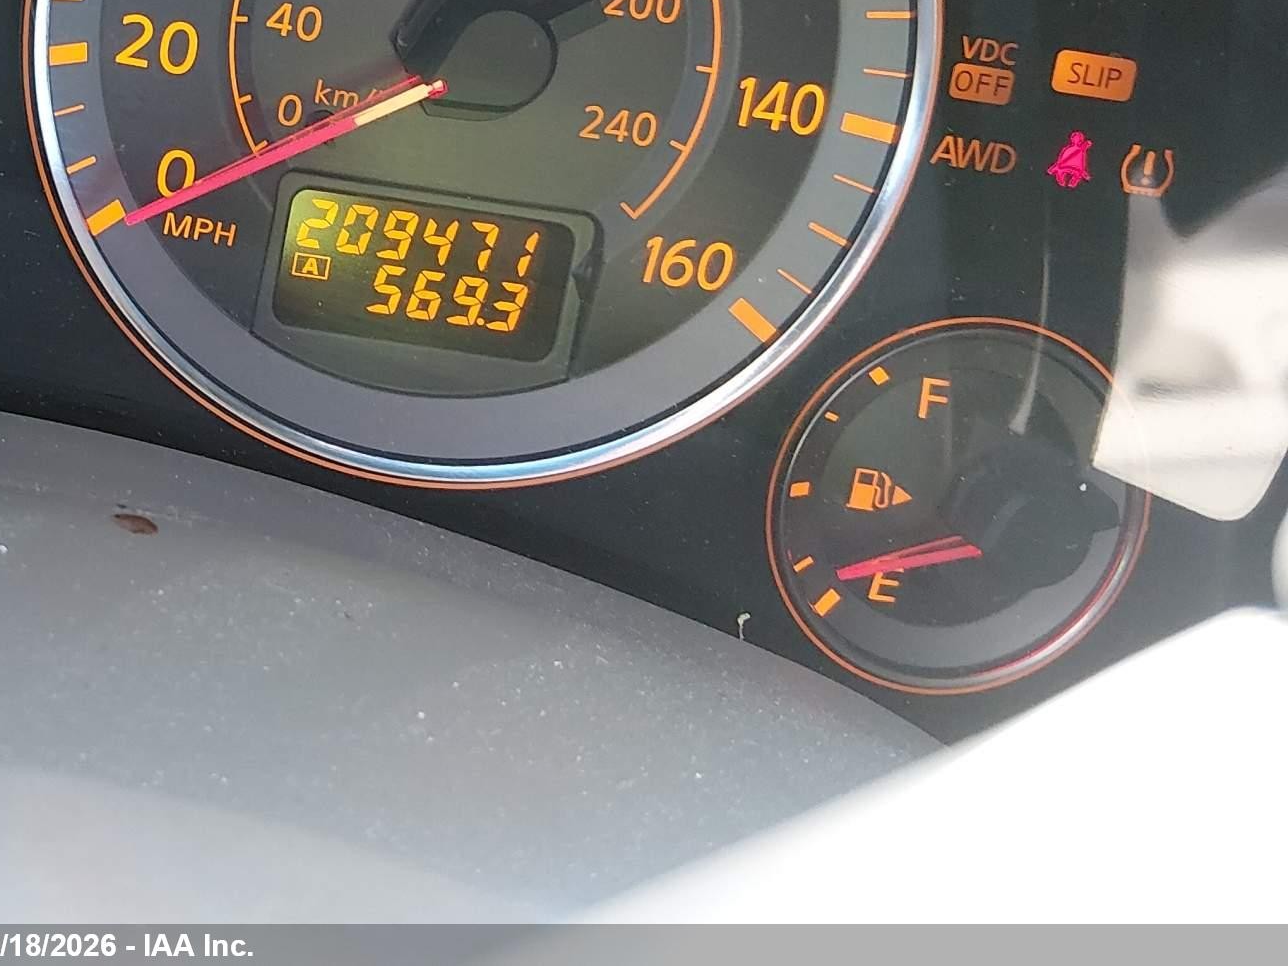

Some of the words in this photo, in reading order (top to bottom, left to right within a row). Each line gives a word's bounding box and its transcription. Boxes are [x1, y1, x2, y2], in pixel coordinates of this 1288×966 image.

[266, 2, 322, 42] 40
[115, 14, 199, 75] 20
[962, 35, 1019, 66] VDC
[954, 69, 1009, 97] OFF
[1067, 62, 1123, 90] SLIP
[277, 94, 303, 127] 0
[578, 105, 657, 147] 240
[736, 76, 826, 136] 140
[157, 149, 196, 198] 0
[930, 135, 1018, 175] AWD
[163, 211, 238, 248] MPH
[296, 198, 540, 278] 209471
[643, 236, 734, 291] 160
[366, 264, 529, 333] 569.3
[918, 376, 951, 419] F
[867, 565, 904, 603] E
